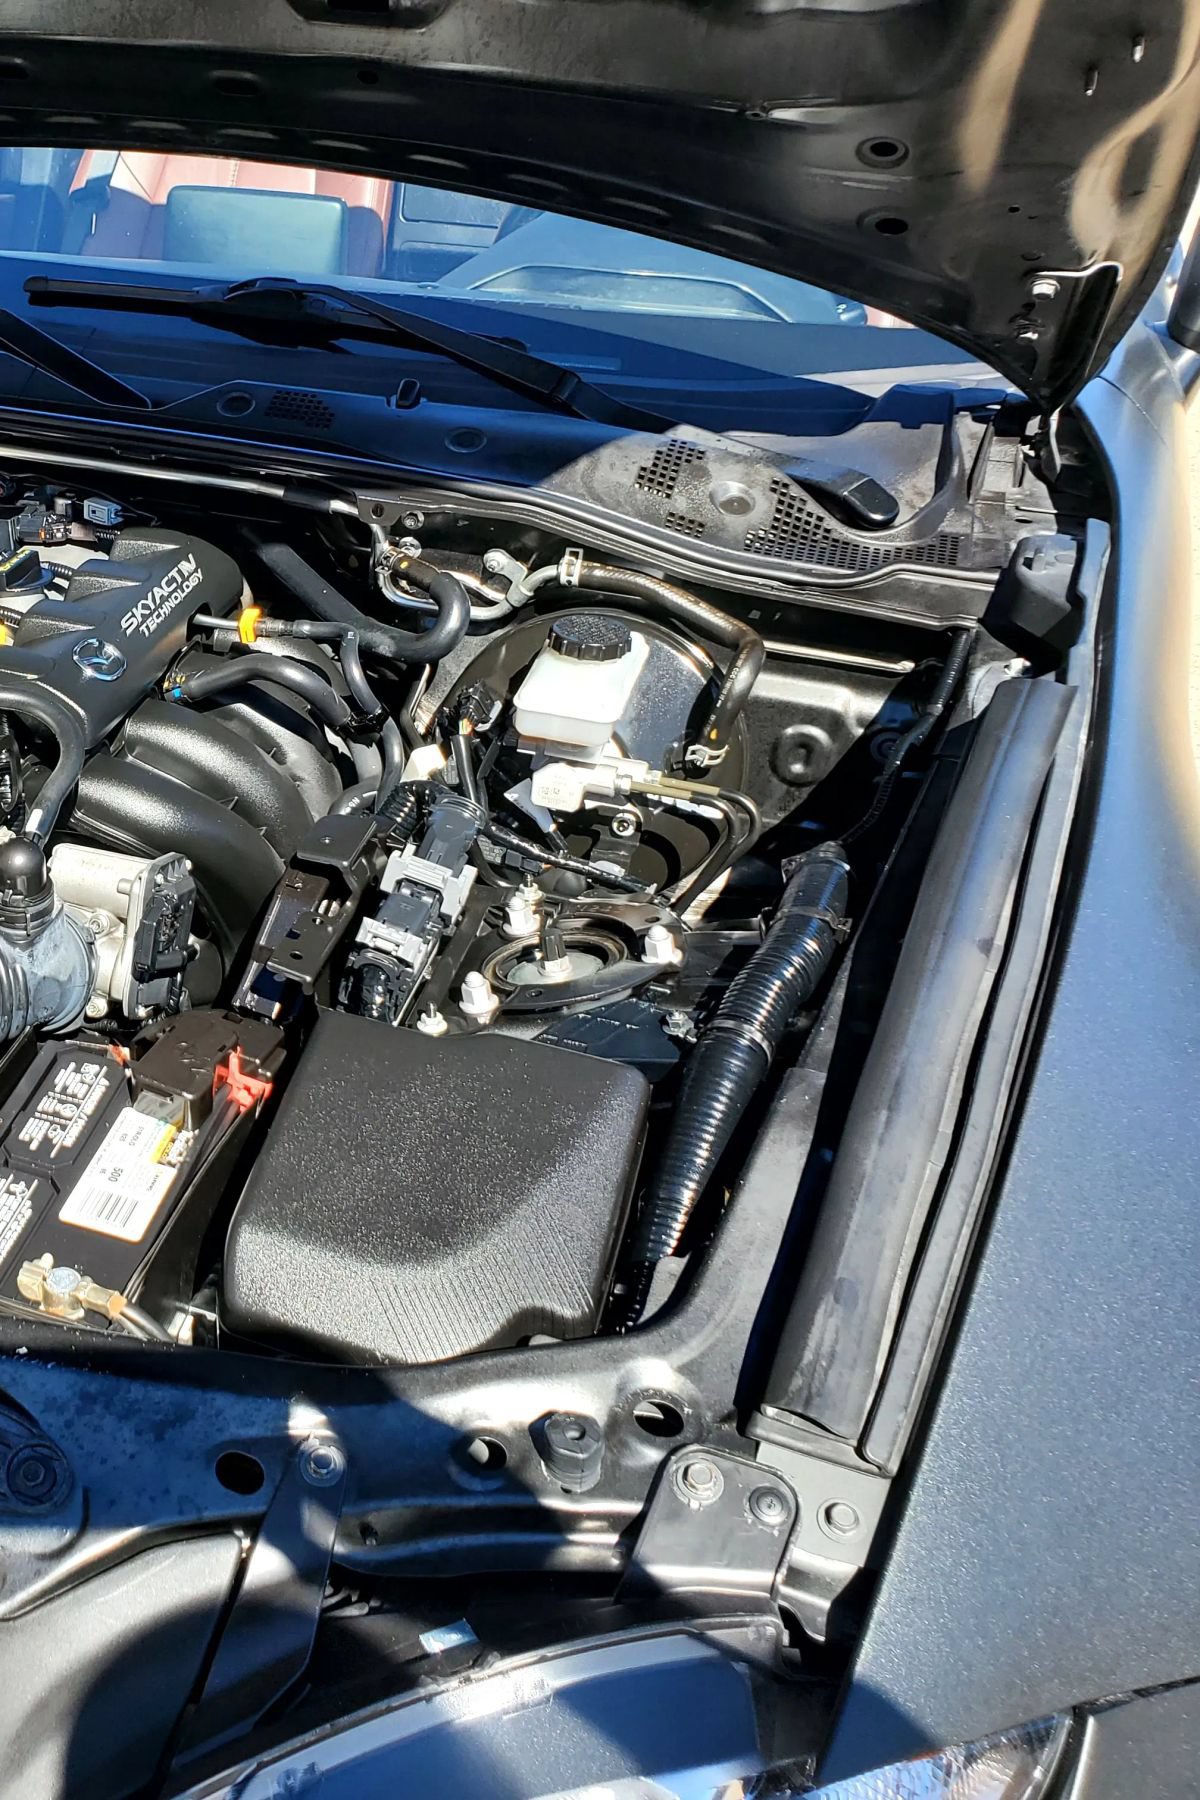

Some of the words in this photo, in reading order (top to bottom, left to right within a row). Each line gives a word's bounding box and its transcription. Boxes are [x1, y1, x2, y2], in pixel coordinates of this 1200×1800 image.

[120, 553, 197, 638] SKYACTIV
[139, 568, 203, 638] TECHNOLOGY
[107, 1165, 124, 1183] 500
